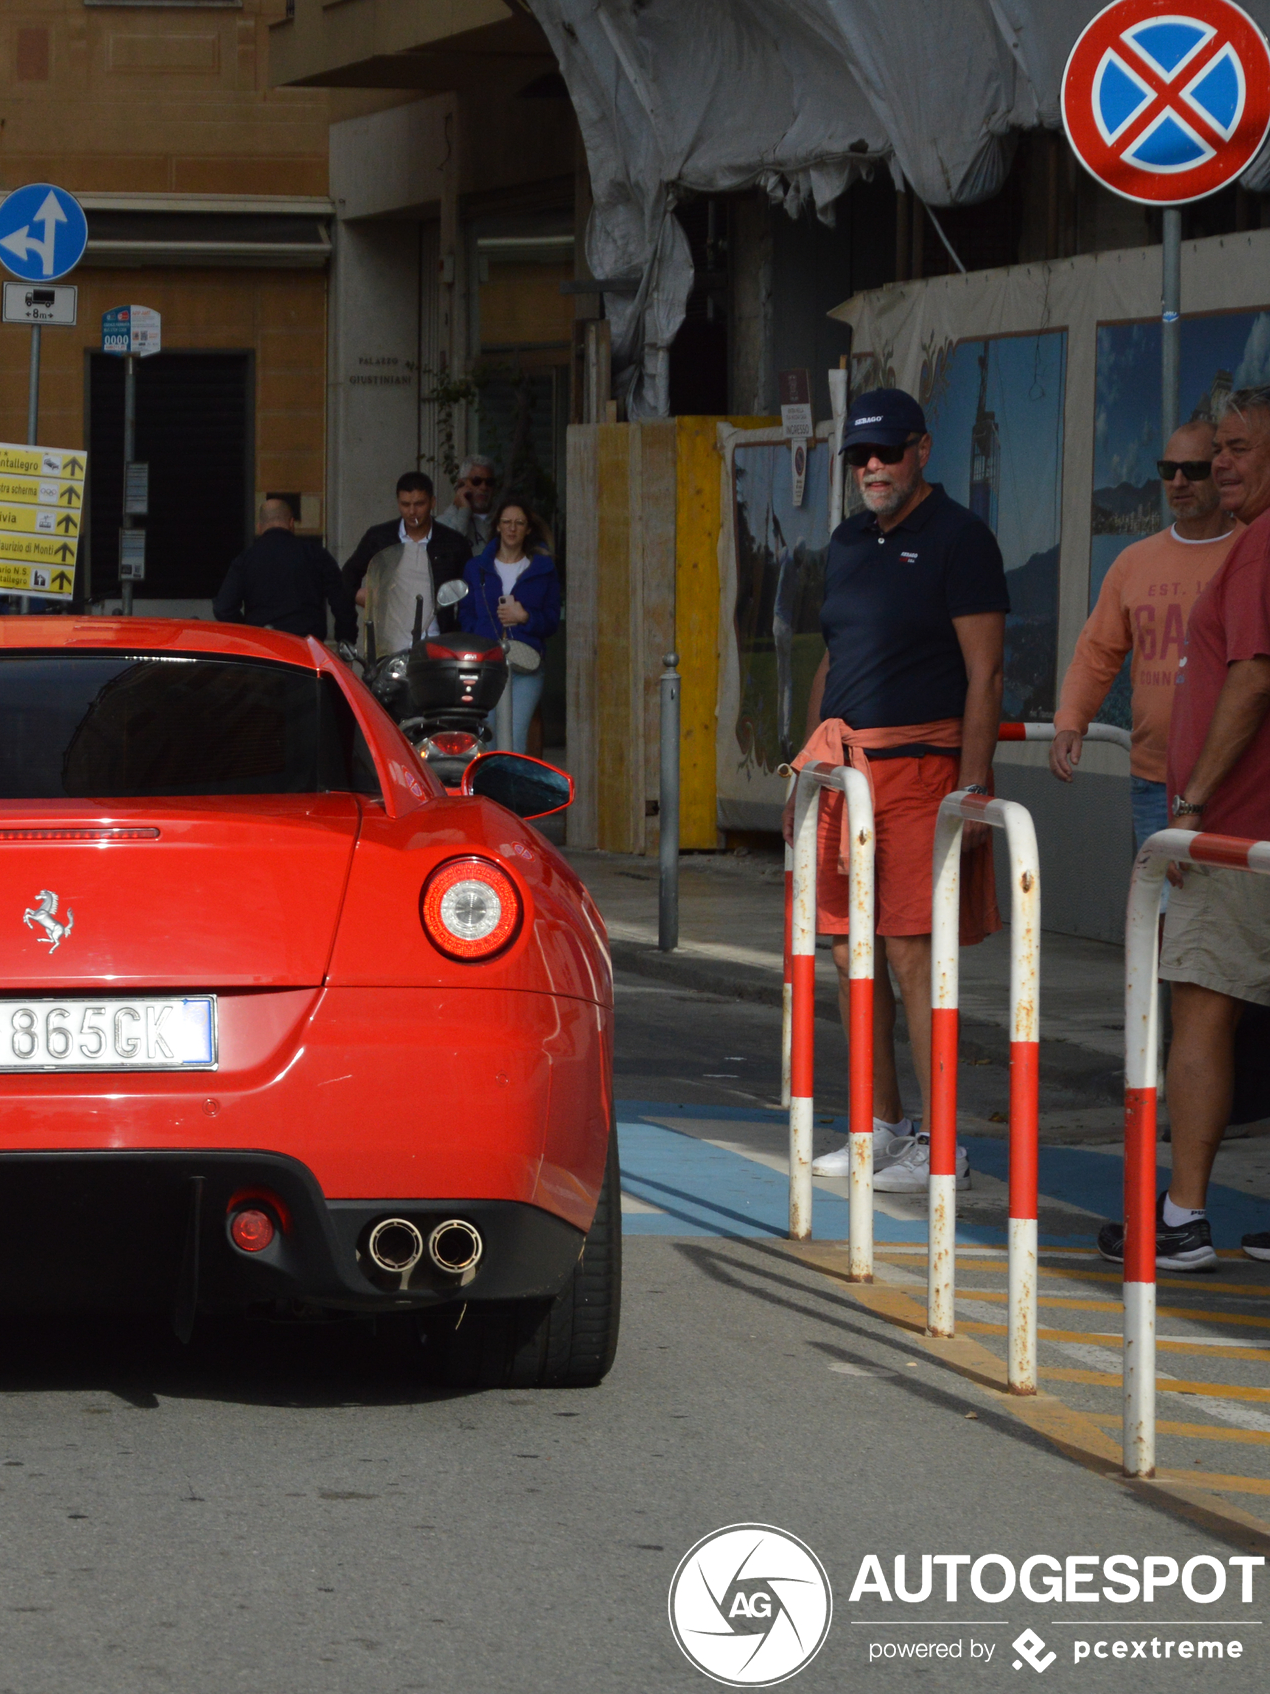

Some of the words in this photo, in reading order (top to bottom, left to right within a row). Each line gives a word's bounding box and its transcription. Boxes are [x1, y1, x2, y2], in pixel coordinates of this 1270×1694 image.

[105, 335, 129, 345] 0000
[854, 416, 882, 426] SEBAGO
[11, 484, 38, 497] scherma
[25, 543, 32, 553] di
[34, 543, 54, 556] Monti
[1148, 582, 1186, 596] EST.
[1134, 604, 1186, 660] GA
[1140, 671, 1180, 686] CONN
[11, 1006, 174, 1059] 865GK
